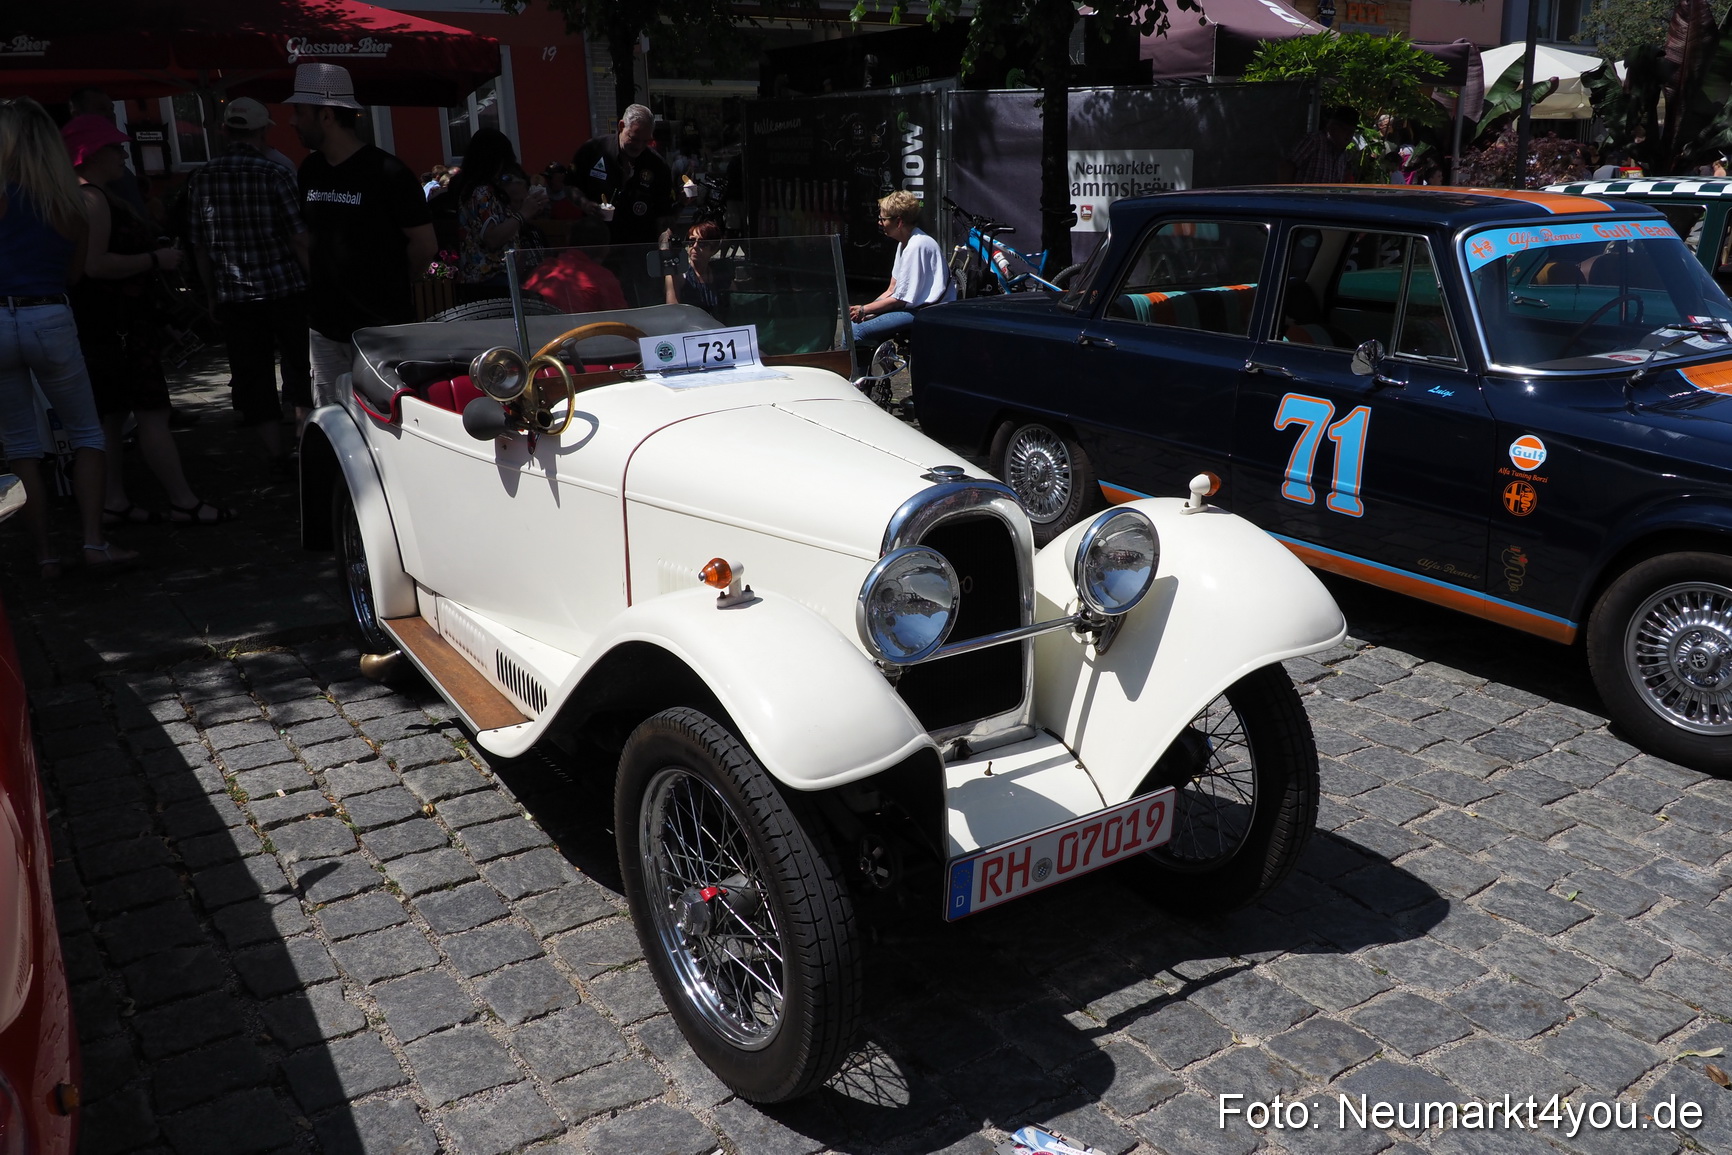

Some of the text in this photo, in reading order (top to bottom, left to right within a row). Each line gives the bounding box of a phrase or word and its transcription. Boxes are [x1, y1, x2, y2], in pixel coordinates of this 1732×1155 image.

[1347, 3, 1386, 24] PEPE
[286, 36, 393, 64] Glossner-Bier
[542, 46, 557, 61] 19
[916, 64, 930, 79] Bio
[1075, 161, 1160, 175] Neumarkter
[1071, 177, 1175, 197] ammsbräu
[1508, 223, 1677, 249] Alfa Romeo Gulf Team
[698, 339, 737, 363] 731
[1427, 385, 1455, 398] Luigi
[1273, 392, 1372, 518] 71
[1512, 446, 1545, 461] Gulf
[1498, 467, 1511, 476] Alfa
[1511, 470, 1532, 482] Tuning
[1416, 557, 1480, 580] Alfa Romeo
[979, 801, 1166, 903] RH 07019
[955, 894, 965, 909] D
